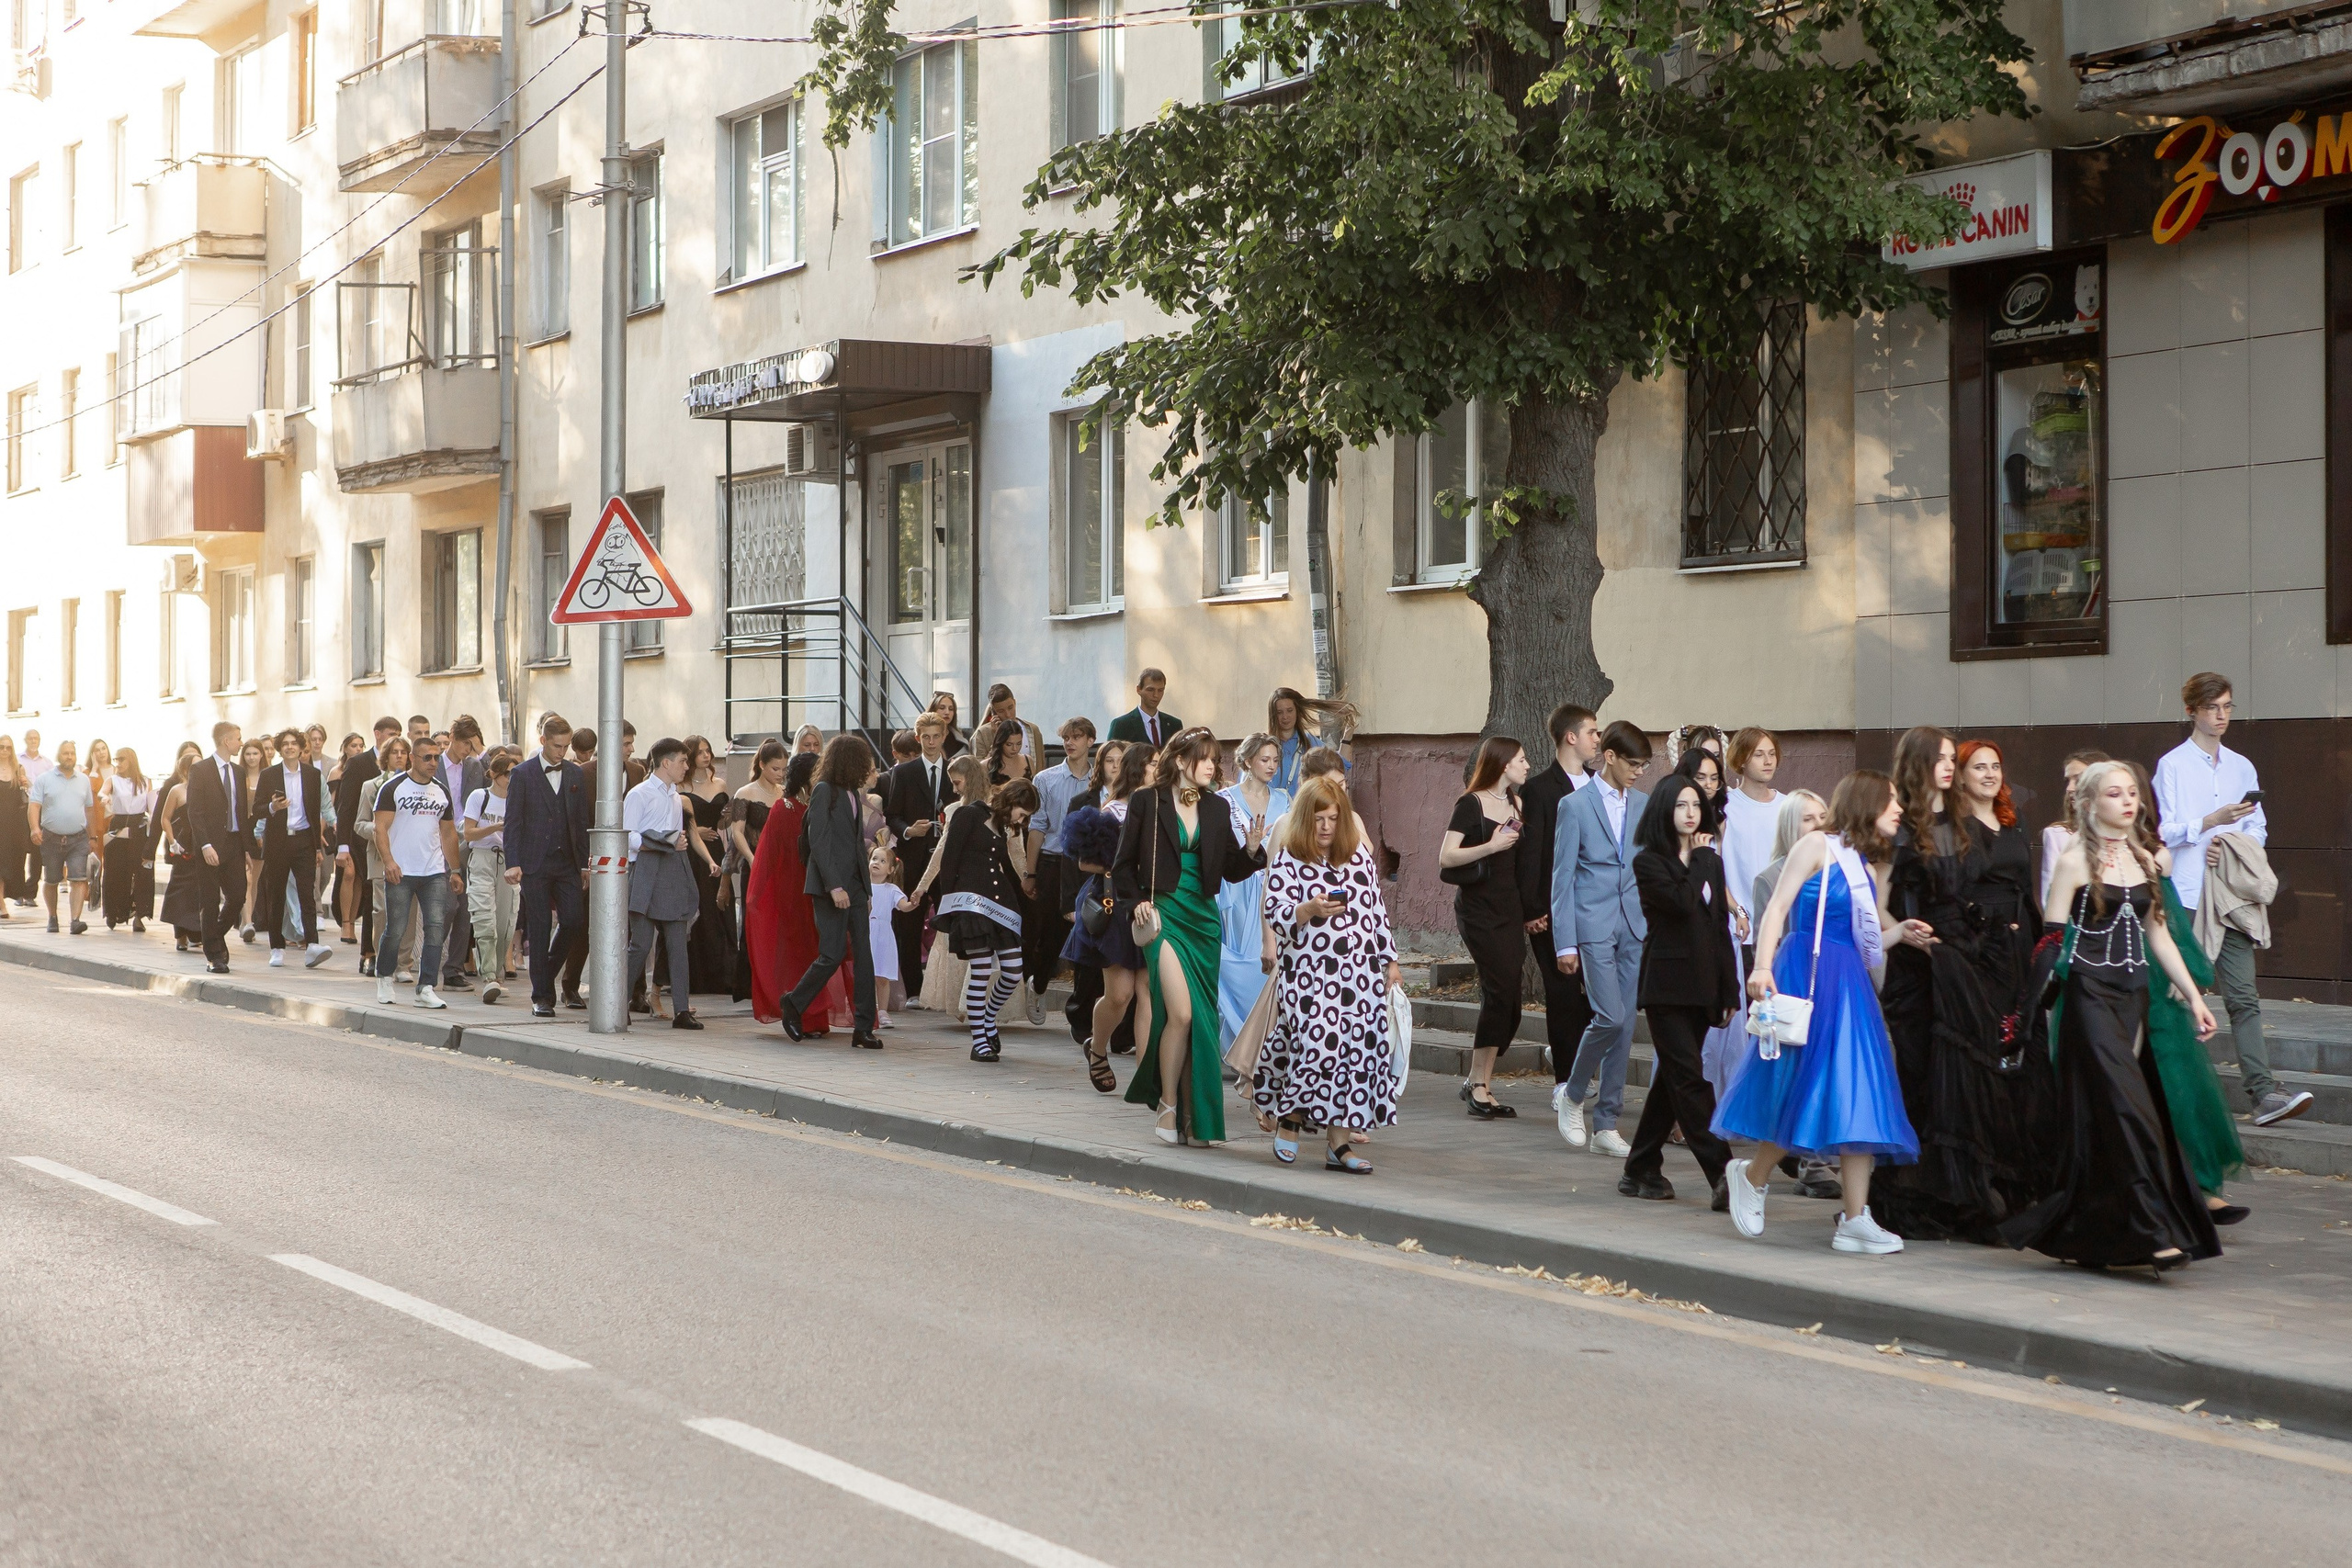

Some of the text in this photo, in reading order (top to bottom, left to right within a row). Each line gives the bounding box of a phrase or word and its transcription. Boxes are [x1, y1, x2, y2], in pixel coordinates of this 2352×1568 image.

[1962, 204, 2030, 244] CANIN
[2007, 285, 2047, 316] Cesar
[966, 894, 1021, 928] Выпускница
